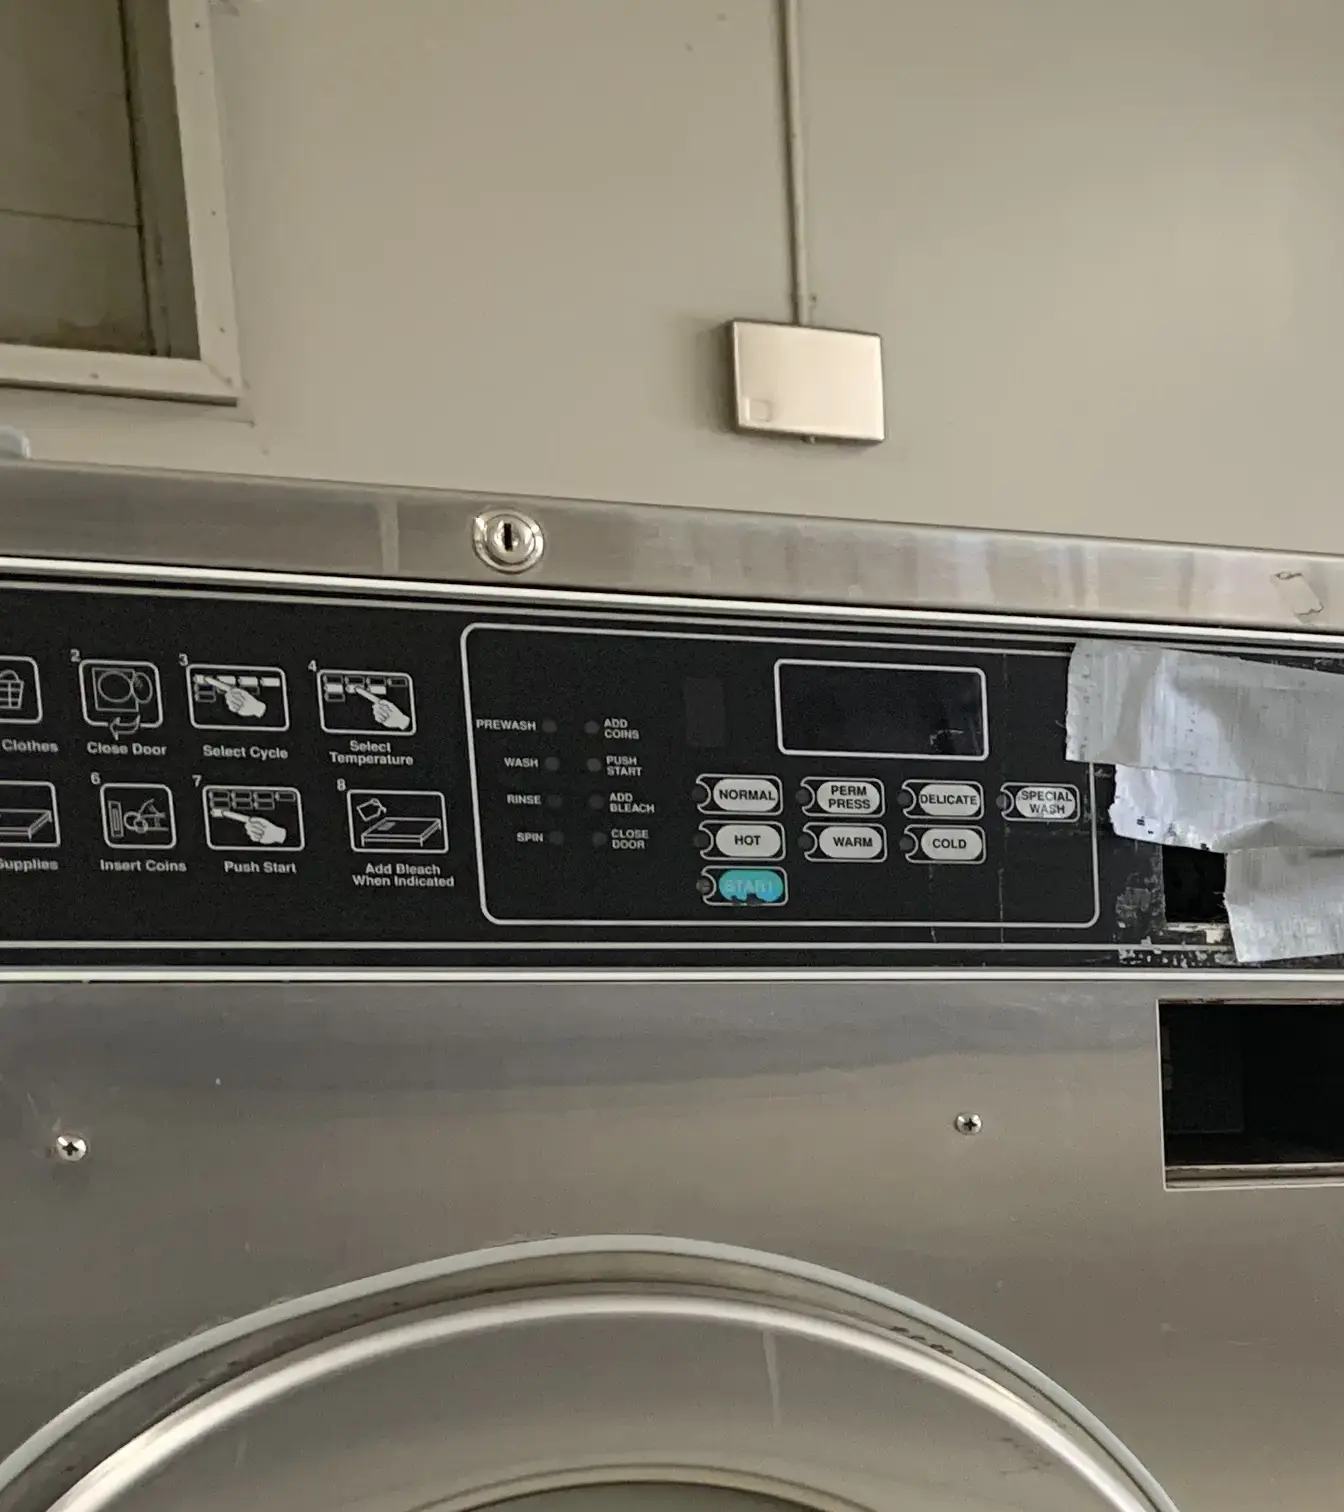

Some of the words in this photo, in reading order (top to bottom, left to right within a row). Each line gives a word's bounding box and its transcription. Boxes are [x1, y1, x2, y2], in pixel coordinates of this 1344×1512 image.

[70, 649, 81, 663] 2
[179, 653, 189, 666] 3
[307, 660, 318, 672] 4
[476, 718, 537, 732] PREWASH
[604, 718, 628, 728] ADD
[604, 729, 640, 740] COINS
[1, 739, 60, 753] Clothes
[86, 741, 129, 755] Close
[132, 743, 167, 756] Door
[349, 740, 392, 753] Select
[203, 745, 246, 758] Select
[250, 746, 288, 761] Cycle
[329, 752, 414, 767] Temperature
[504, 757, 539, 768] WASH
[606, 755, 637, 766] PUSH
[606, 766, 642, 777] START
[90, 772, 101, 785] 6
[191, 775, 202, 787] 7
[337, 778, 346, 791] 8
[609, 792, 633, 802] ADD
[718, 789, 776, 801] NORMAL
[830, 785, 868, 797] PERM
[1020, 790, 1073, 803] SPECIAL
[507, 794, 542, 805] RINSE
[828, 798, 871, 810] PRESS
[919, 794, 978, 806] DELICATE
[610, 803, 656, 814] BLEACH
[1029, 802, 1066, 816] WASH
[516, 832, 544, 843] SPIN
[611, 829, 649, 839] CLOSE
[612, 839, 645, 849] DOOR
[734, 834, 761, 847] HOT
[832, 836, 873, 848] WARM
[932, 837, 967, 850] COLD
[100, 859, 142, 872] Insert
[145, 860, 188, 873] Coins
[223, 861, 260, 873] Push
[263, 861, 297, 874] Start
[365, 863, 393, 875] Add
[396, 863, 441, 875] Bleach
[352, 875, 390, 886] When
[394, 875, 455, 887] Indicated
